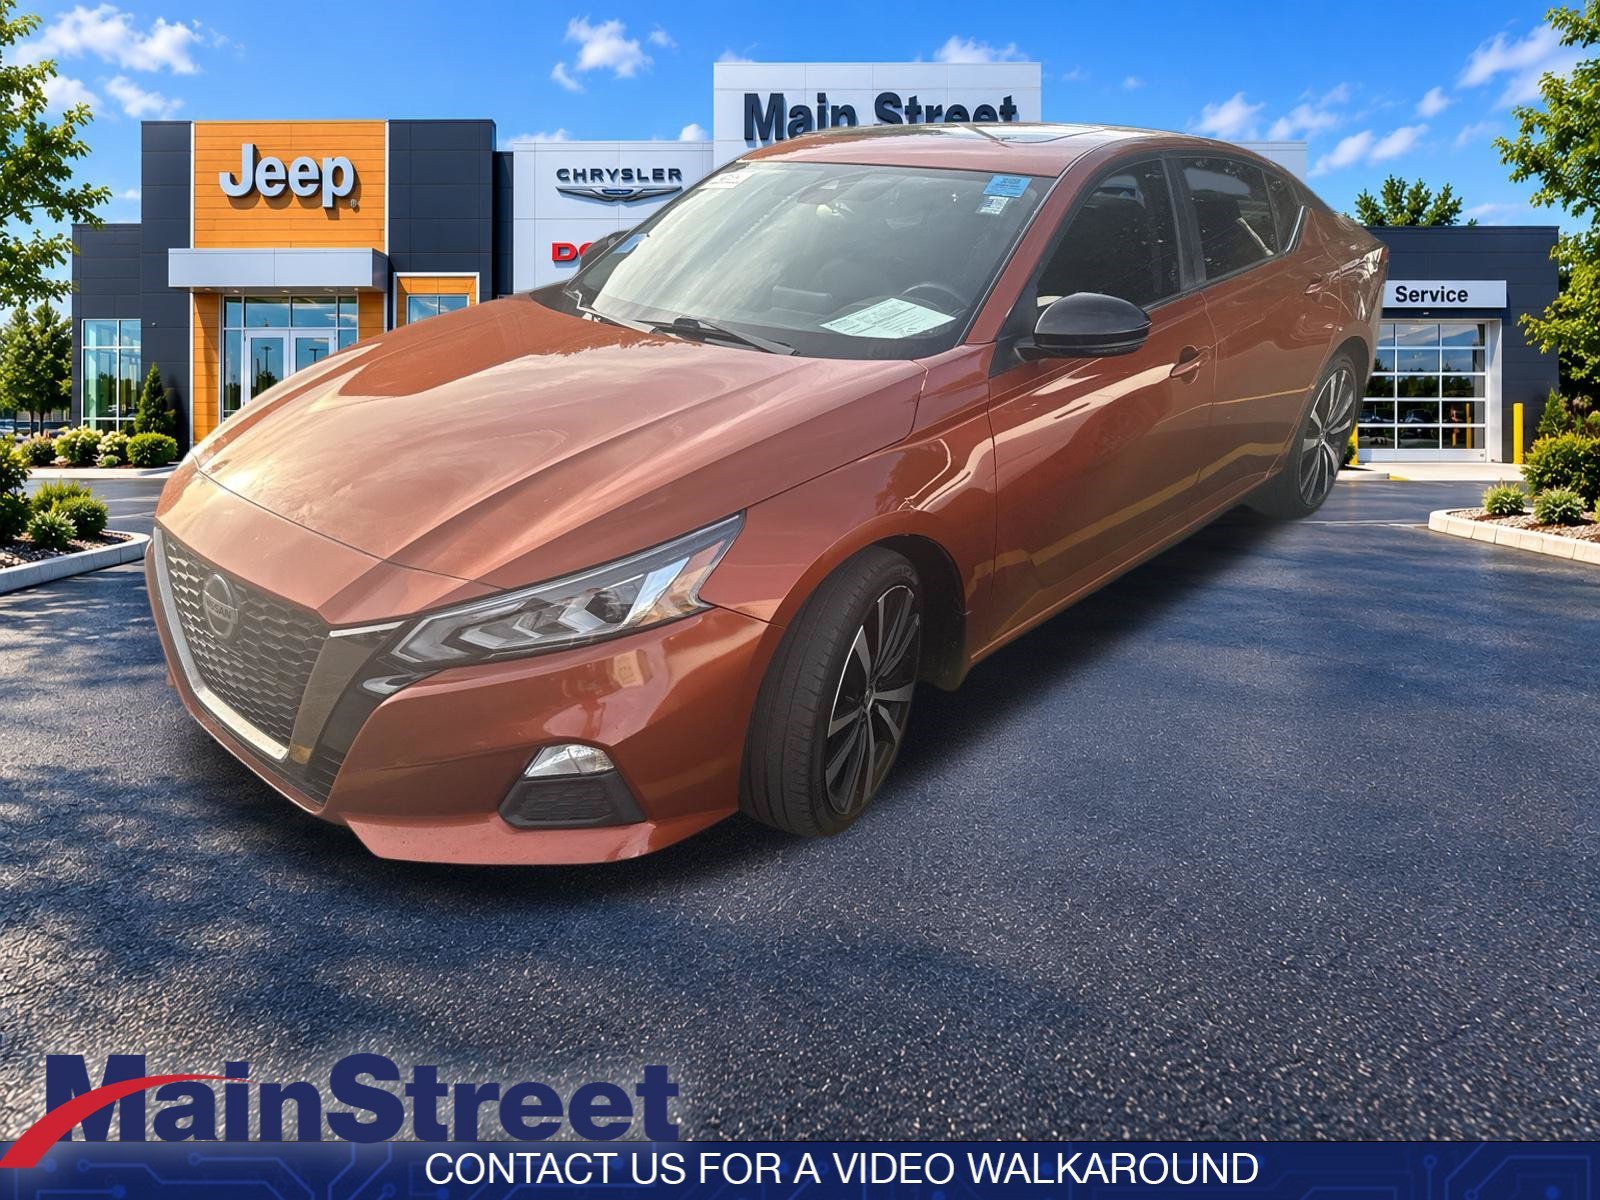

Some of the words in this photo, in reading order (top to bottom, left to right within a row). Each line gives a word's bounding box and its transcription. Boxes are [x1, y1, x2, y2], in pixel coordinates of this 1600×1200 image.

[744, 92, 857, 140] Main
[218, 143, 355, 208] Jeep
[556, 168, 682, 182] CHRYSLER
[551, 242, 593, 262] D
[1395, 285, 1469, 303] Service
